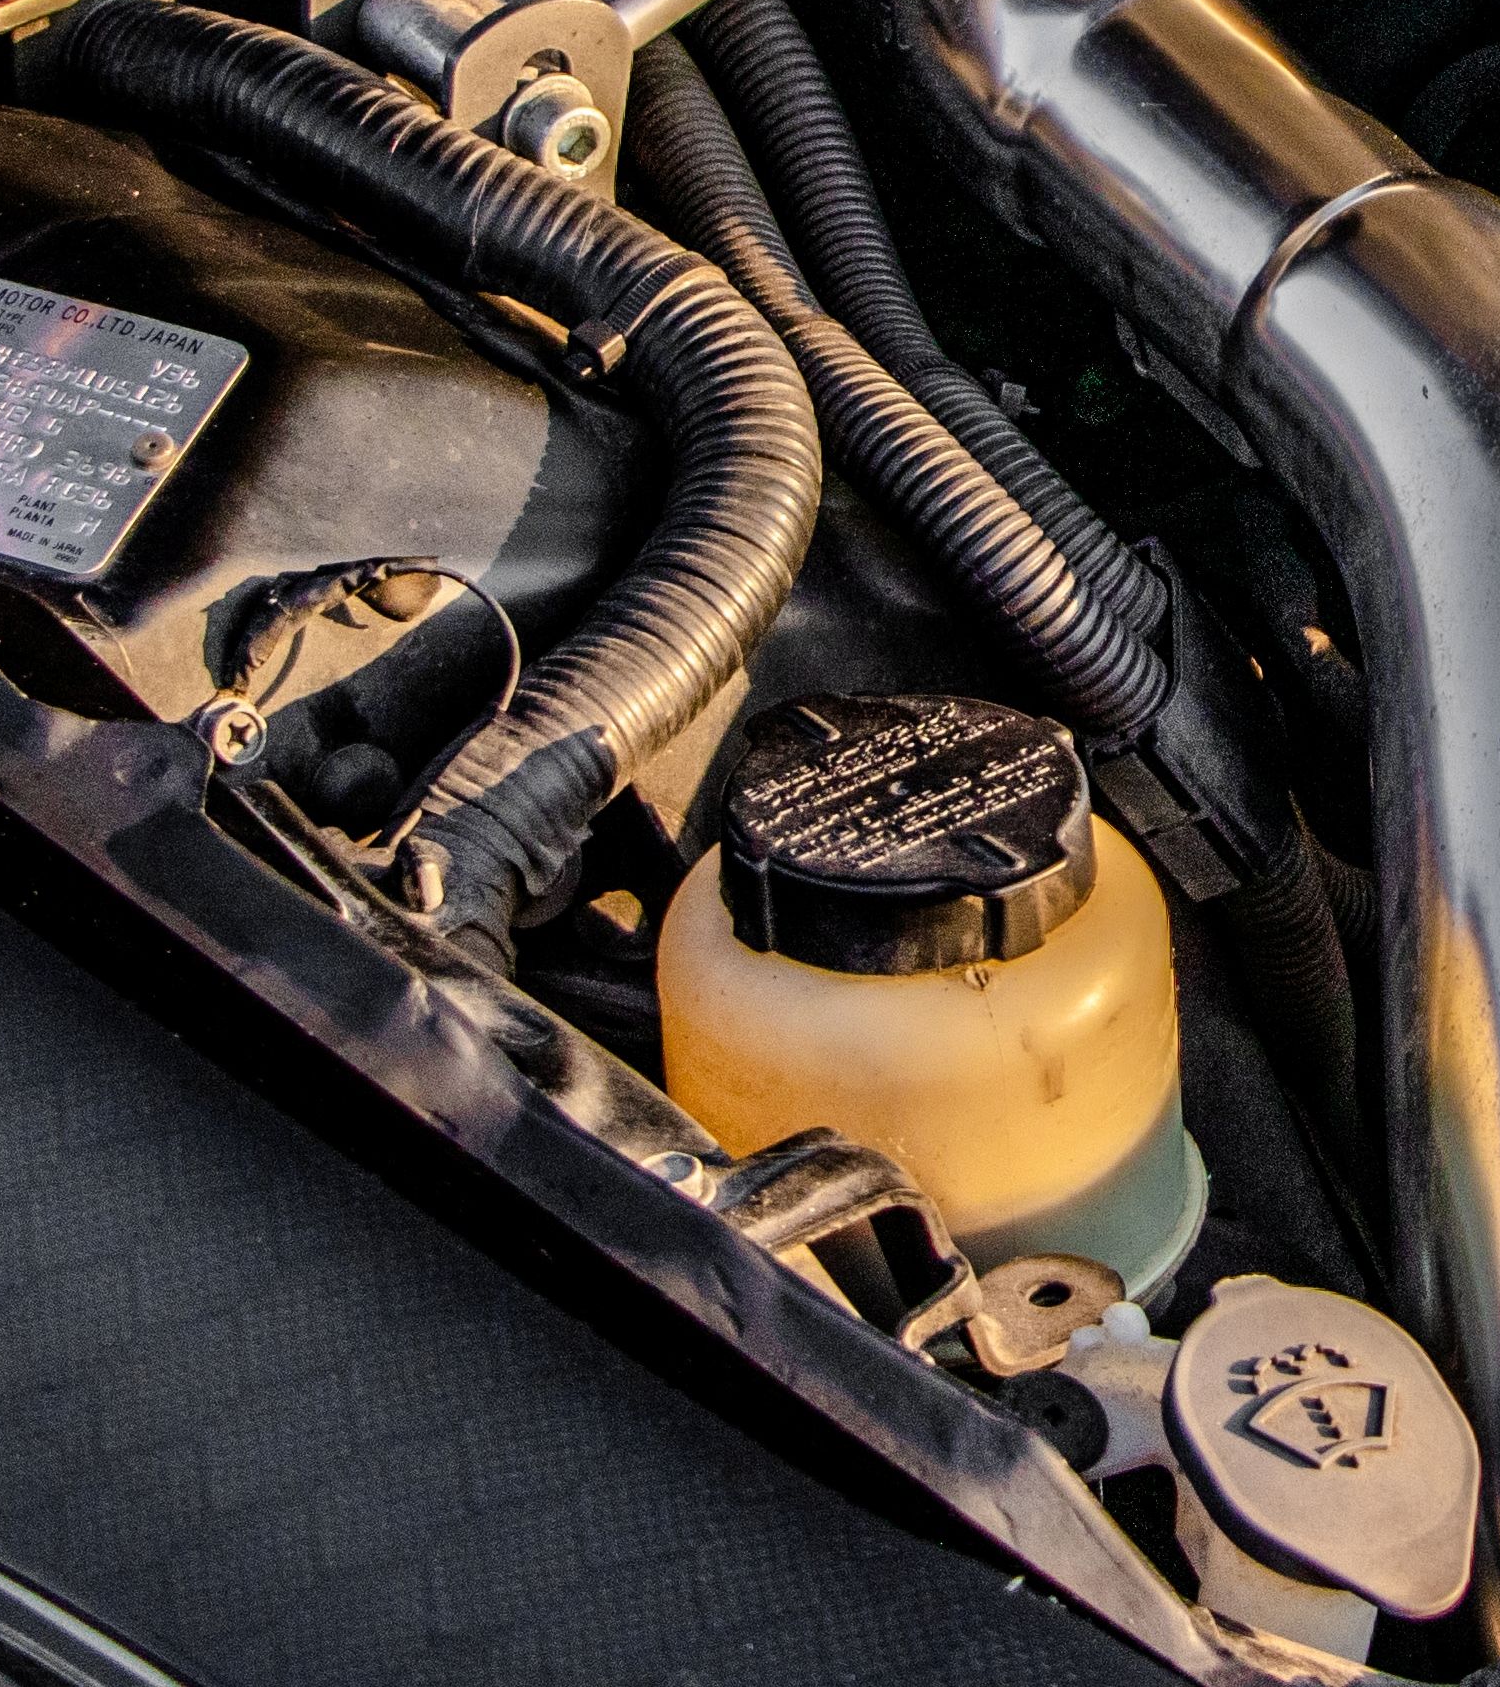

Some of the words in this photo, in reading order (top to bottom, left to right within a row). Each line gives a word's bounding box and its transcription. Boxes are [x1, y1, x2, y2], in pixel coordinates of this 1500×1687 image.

[144, 358, 207, 391] V36
[7, 504, 58, 528] PLANTA
[15, 493, 58, 514] PLANT
[5, 526, 37, 544] MADE
[36, 536, 51, 548] IN
[51, 539, 86, 557] JAPAN
